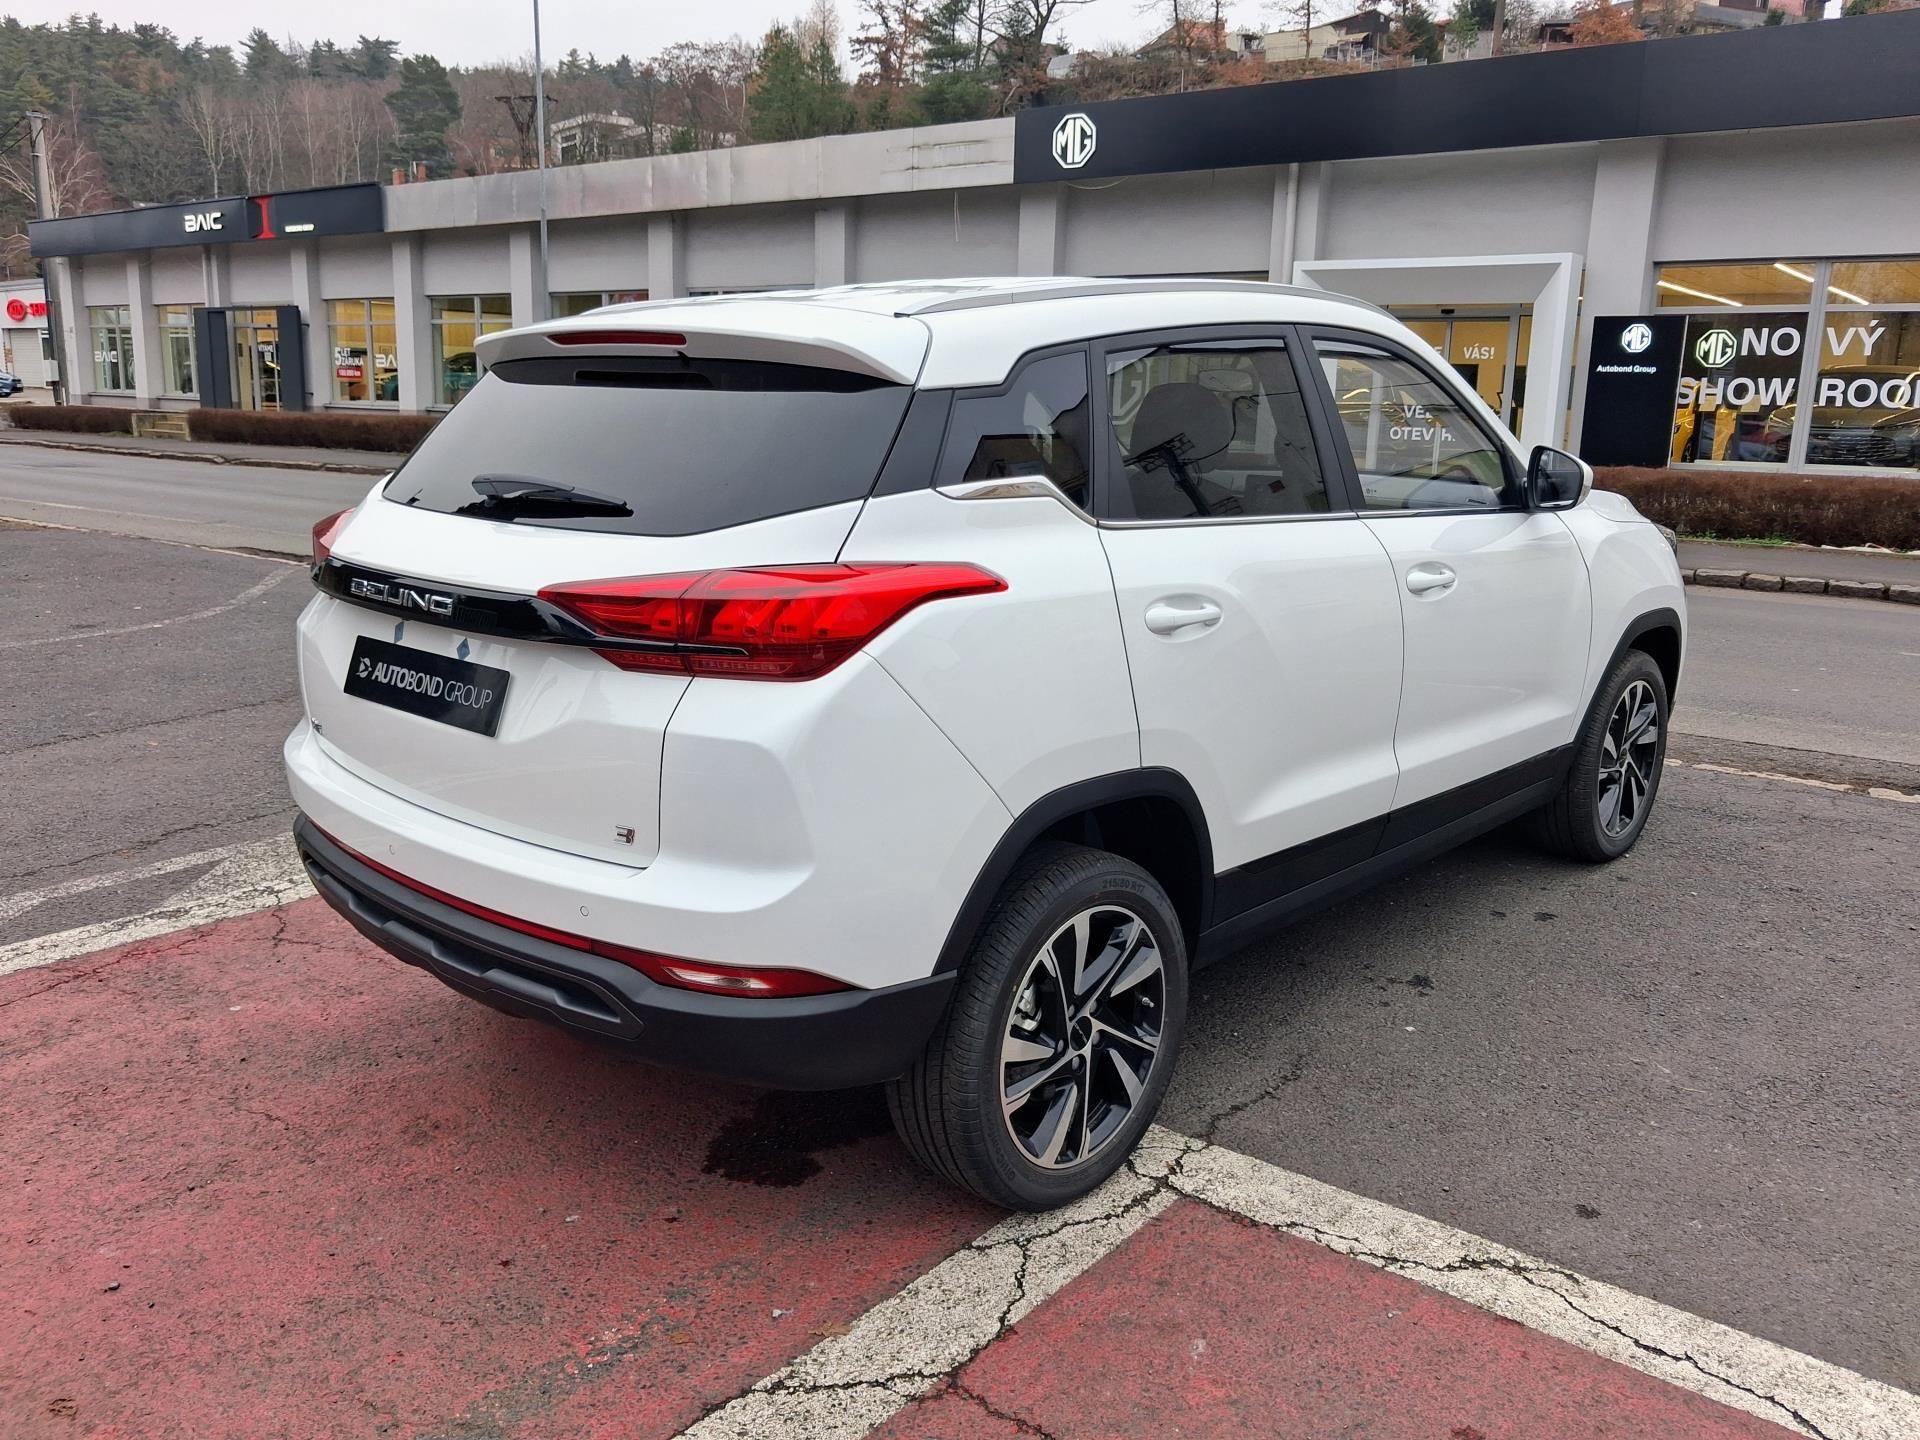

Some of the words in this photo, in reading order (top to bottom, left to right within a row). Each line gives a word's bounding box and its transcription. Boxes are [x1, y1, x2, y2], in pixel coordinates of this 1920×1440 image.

[1054, 114, 1096, 167] MG
[184, 212, 223, 232] BAIC
[1463, 343, 1495, 360] VÁS!
[1622, 324, 1651, 352] MG
[1696, 329, 1737, 367] MG
[94, 351, 118, 362] BAIC
[1596, 365, 1632, 373] Autobond
[1633, 365, 1657, 374] Group
[1678, 377, 1796, 406] SHOW
[1818, 379, 1920, 408] ROO
[350, 577, 453, 616] BEIJING
[371, 662, 444, 698] AUTOBOND
[444, 680, 493, 710] GROUP
